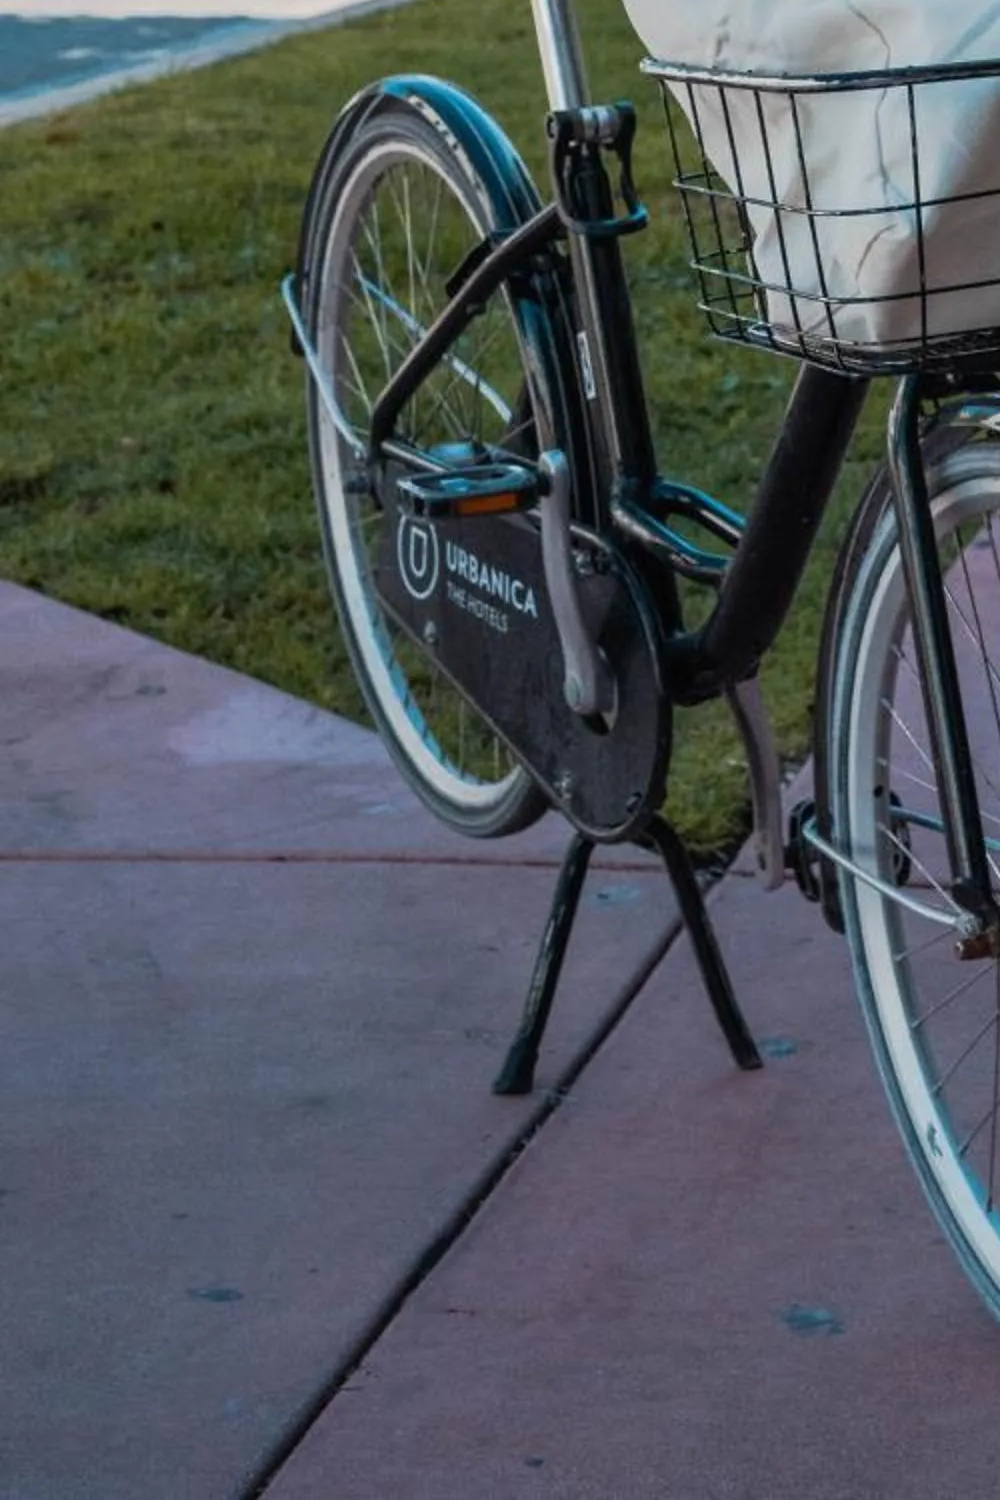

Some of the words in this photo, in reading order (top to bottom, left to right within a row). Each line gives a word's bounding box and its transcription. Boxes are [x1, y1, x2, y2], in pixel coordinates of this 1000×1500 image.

[446, 540, 538, 619] URBANICA
[447, 581, 467, 609] THE
[467, 593, 509, 632] HOTELS
